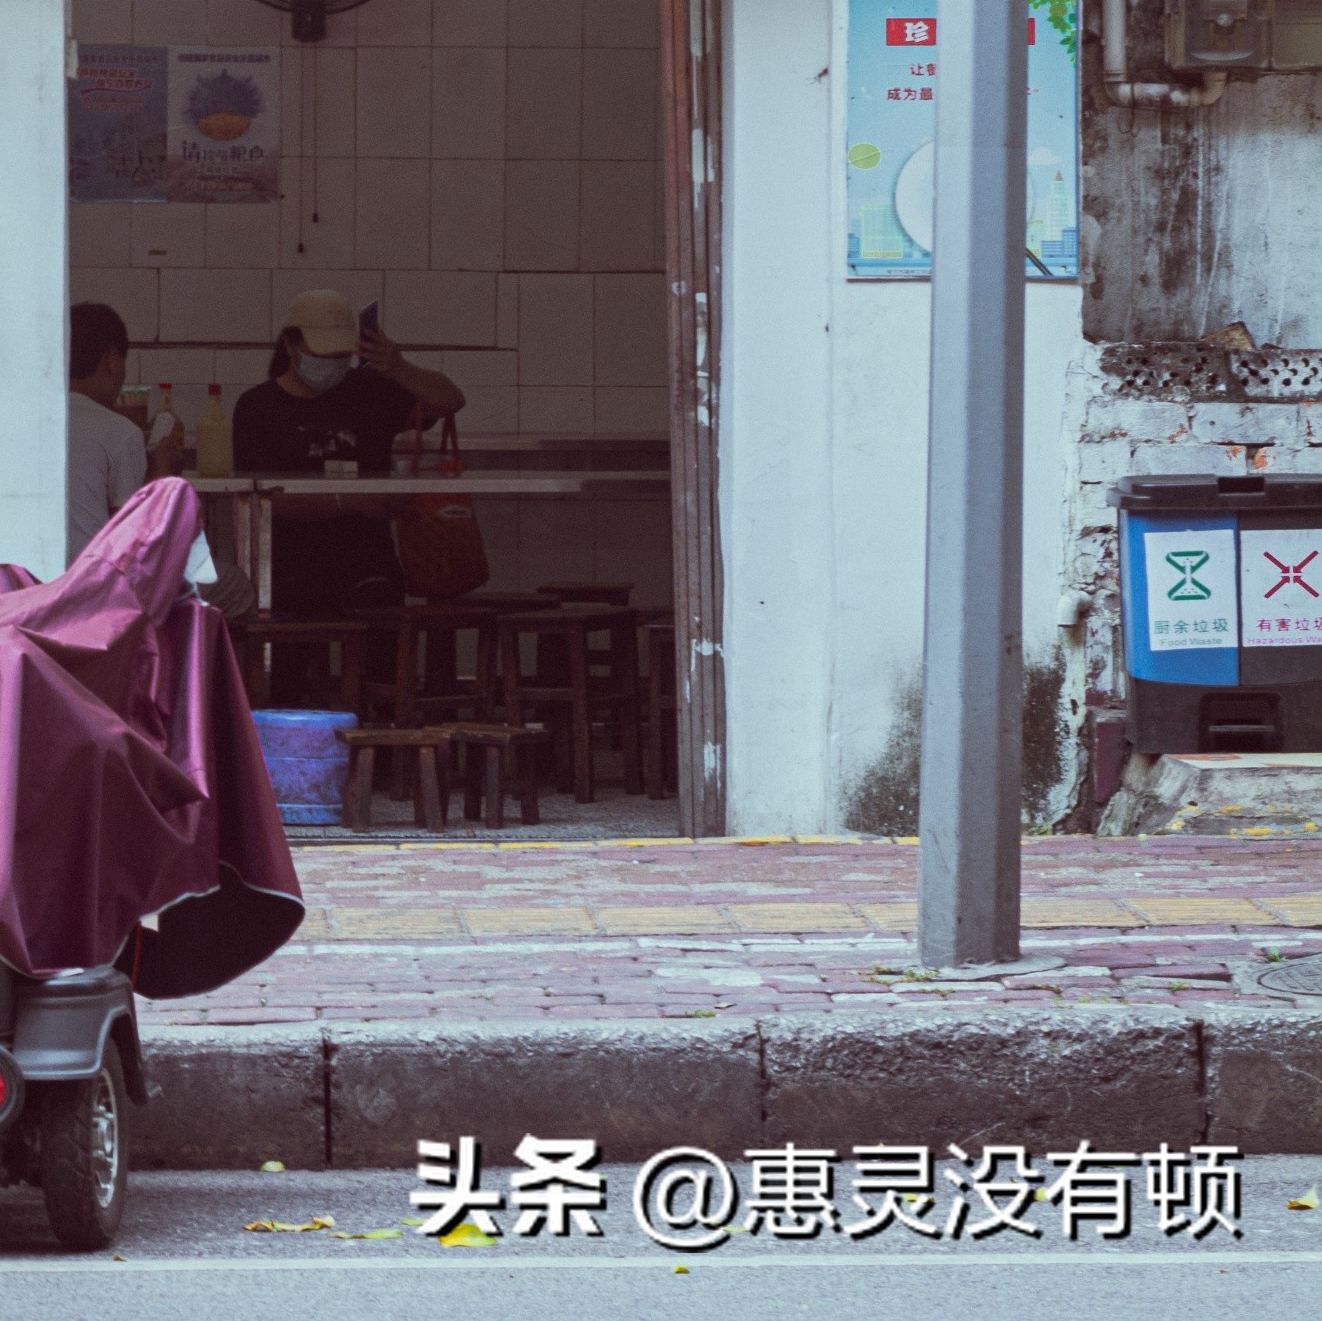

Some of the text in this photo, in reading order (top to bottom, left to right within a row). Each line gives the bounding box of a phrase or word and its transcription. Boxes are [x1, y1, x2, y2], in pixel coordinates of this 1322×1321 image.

[1154, 618, 1229, 635] 厨余垃圾
[1160, 637, 1222, 647] Food Waste
[1247, 636, 1303, 645] Hazardous
